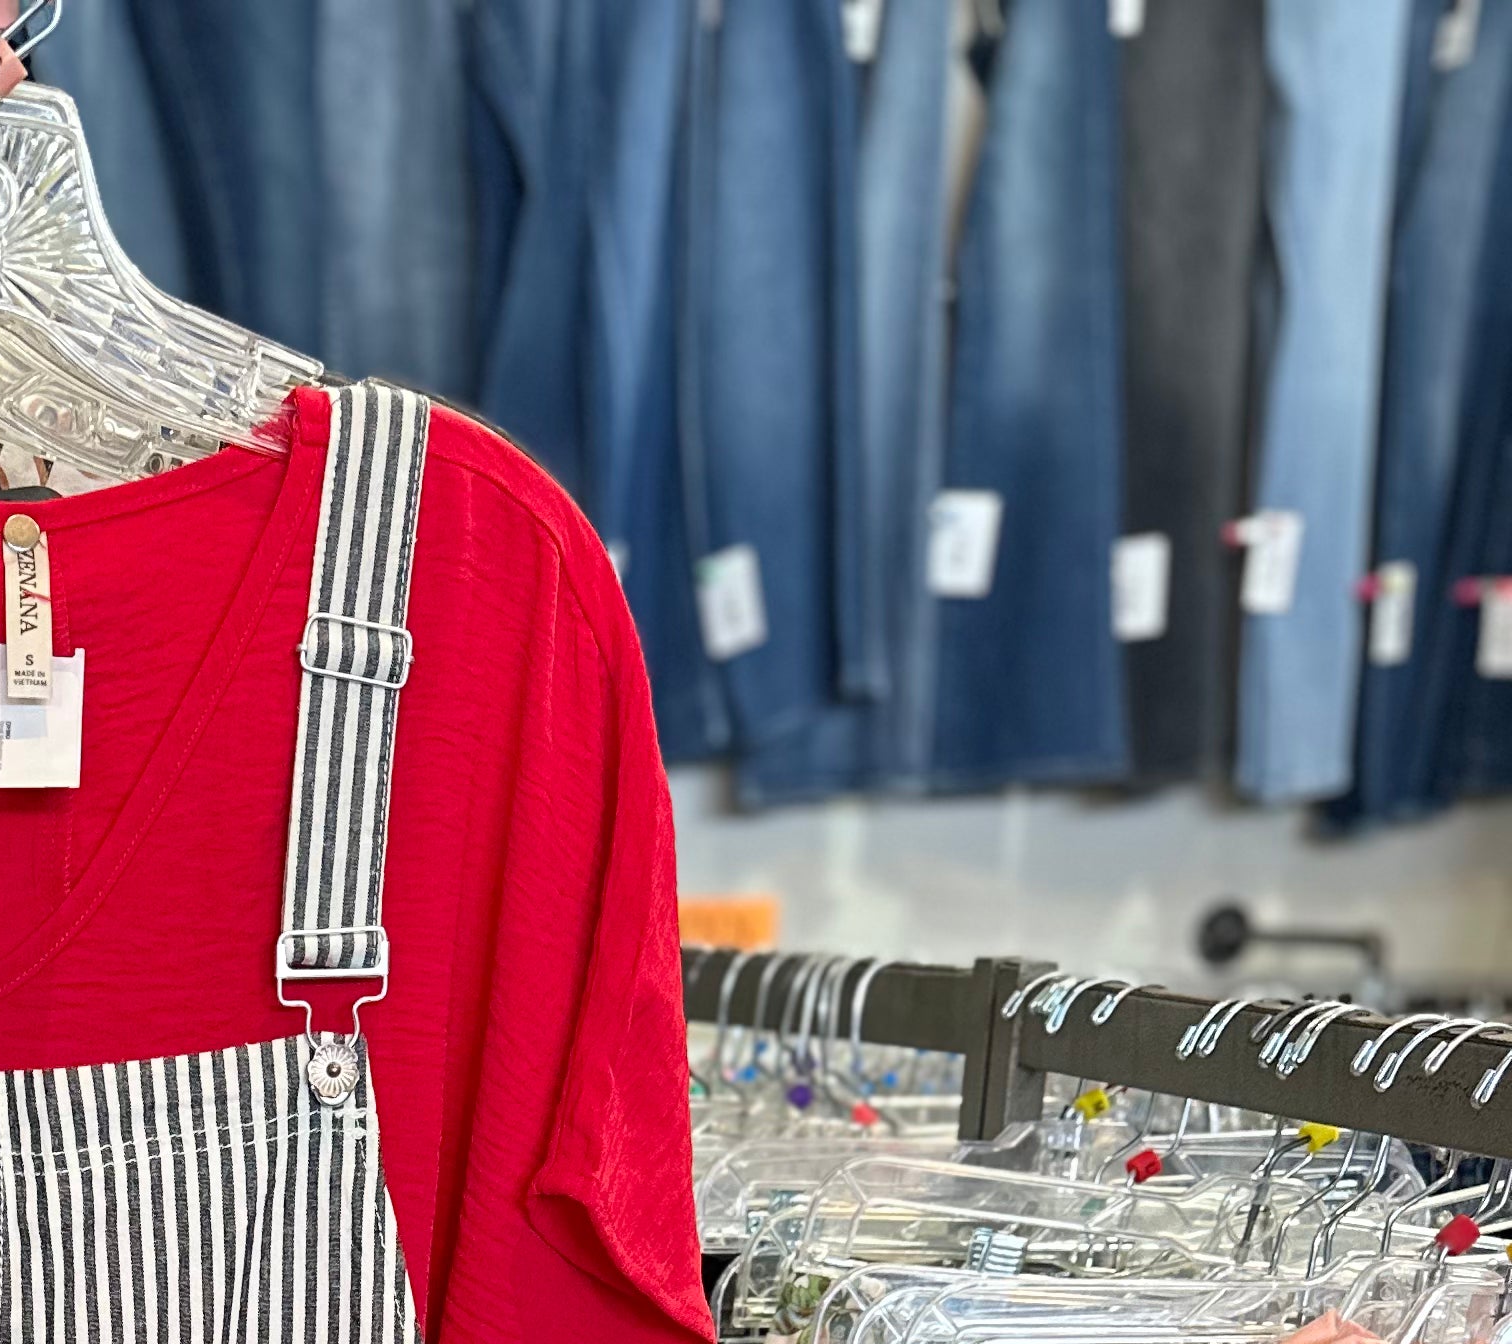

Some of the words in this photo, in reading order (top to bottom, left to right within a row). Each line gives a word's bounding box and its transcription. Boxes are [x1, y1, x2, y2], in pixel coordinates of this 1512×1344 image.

[17, 547, 39, 637] ZENANA
[25, 654, 34, 666] S
[13, 678, 48, 687] VIETNAM
